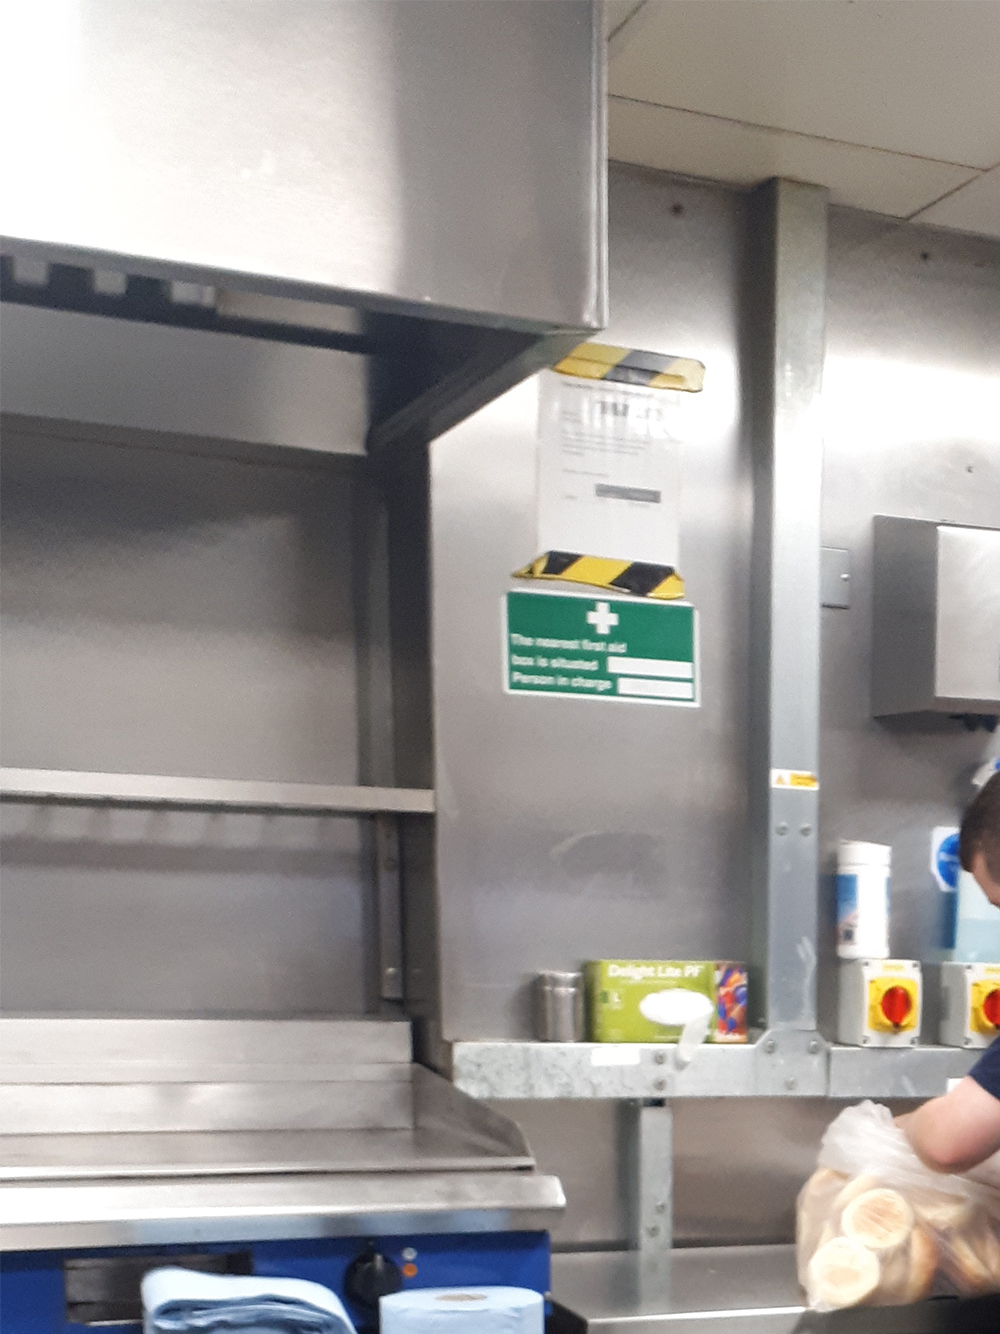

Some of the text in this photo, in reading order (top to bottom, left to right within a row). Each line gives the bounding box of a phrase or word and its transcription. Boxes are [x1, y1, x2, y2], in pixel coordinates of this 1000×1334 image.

[510, 633, 627, 653] The nearest first aid
[511, 654, 598, 671] box is situated
[512, 671, 612, 692] Person in charge
[608, 964, 655, 980] Delight
